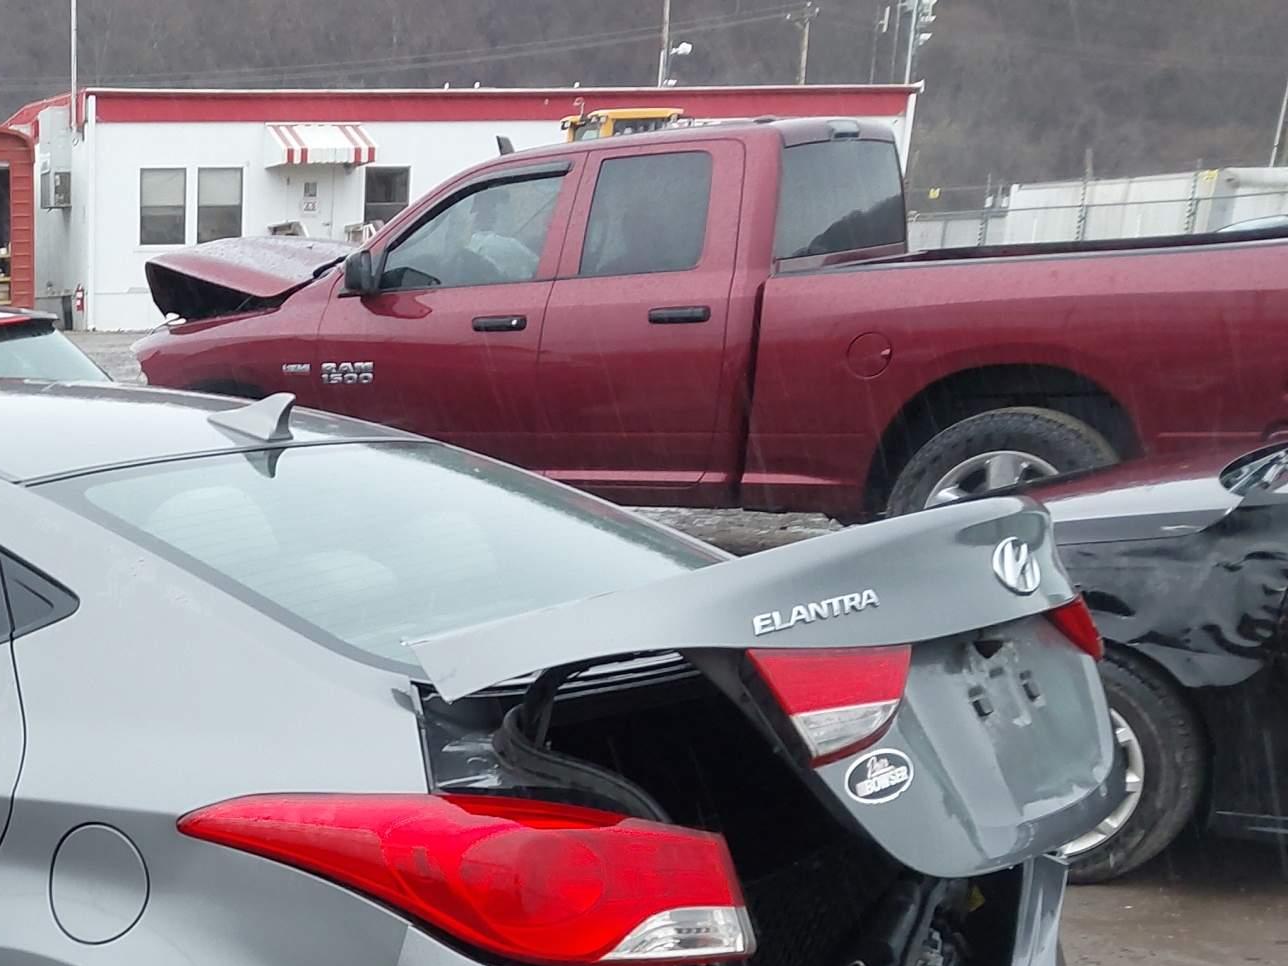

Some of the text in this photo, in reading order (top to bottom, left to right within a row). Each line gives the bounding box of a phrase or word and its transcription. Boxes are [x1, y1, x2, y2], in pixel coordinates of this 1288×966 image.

[320, 361, 374, 373] RAM
[320, 373, 374, 384] 1500
[752, 589, 881, 637] ELANTRA
